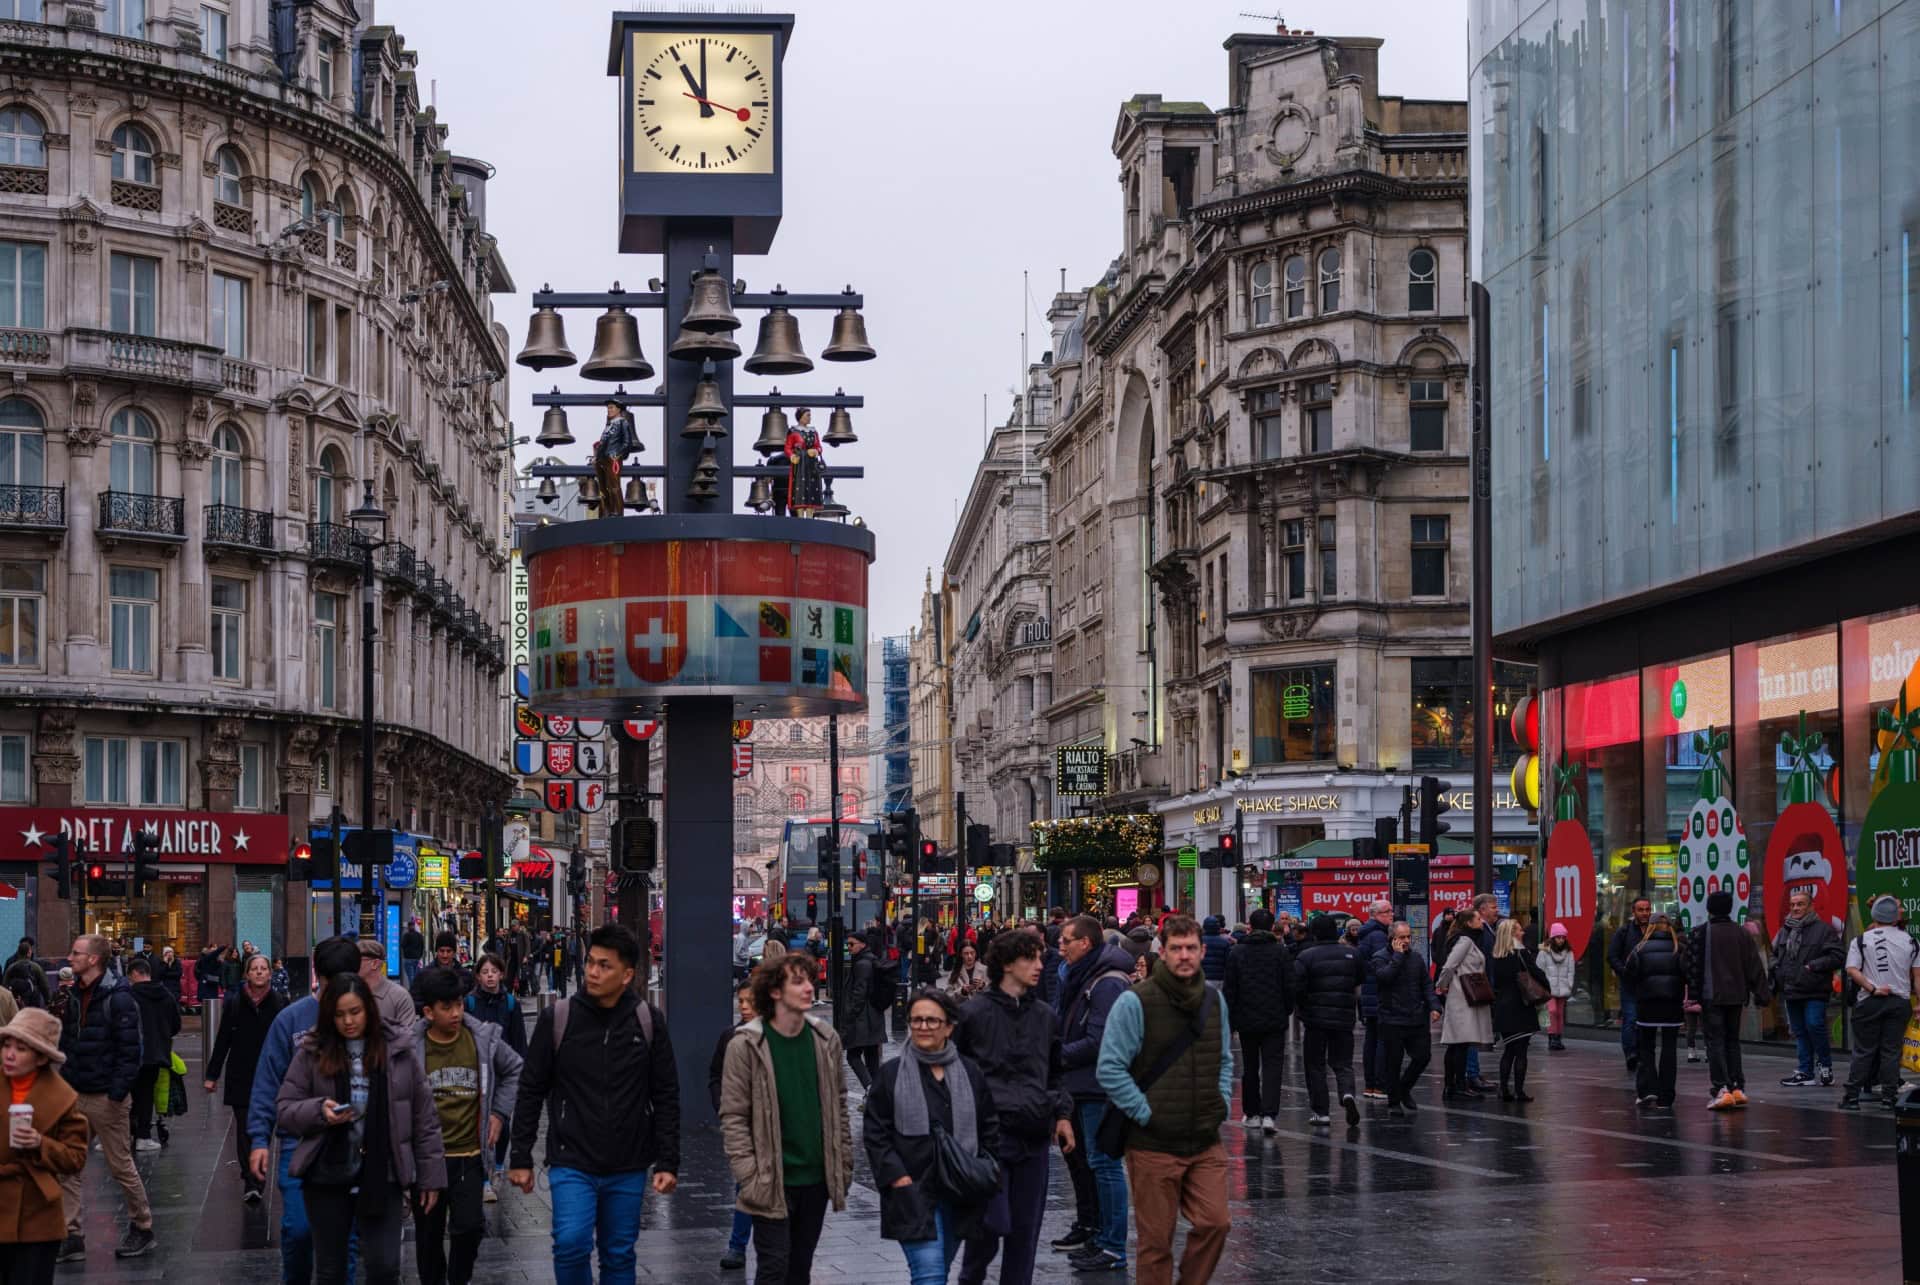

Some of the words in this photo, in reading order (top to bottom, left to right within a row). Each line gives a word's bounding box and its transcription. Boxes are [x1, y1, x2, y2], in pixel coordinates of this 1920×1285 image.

[515, 564, 528, 596] THE
[515, 601, 528, 651] BOOK
[1065, 750, 1100, 765] RIALTO
[1066, 765, 1099, 774] BACKSTAGE
[1075, 782, 1097, 791] CASINO
[1076, 774, 1089, 783] BAR
[1236, 797, 1283, 813] SHAKE
[1288, 794, 1338, 811] SHACK
[1409, 792, 1473, 810] SAKE
[60, 817, 115, 853] PRET
[143, 818, 222, 854] MANGER
[1344, 859, 1361, 867] Hop
[1334, 873, 1355, 883] Buy
[1313, 892, 1340, 906] Buy
[1343, 892, 1378, 903] Your
[1434, 889, 1471, 901] Here!
